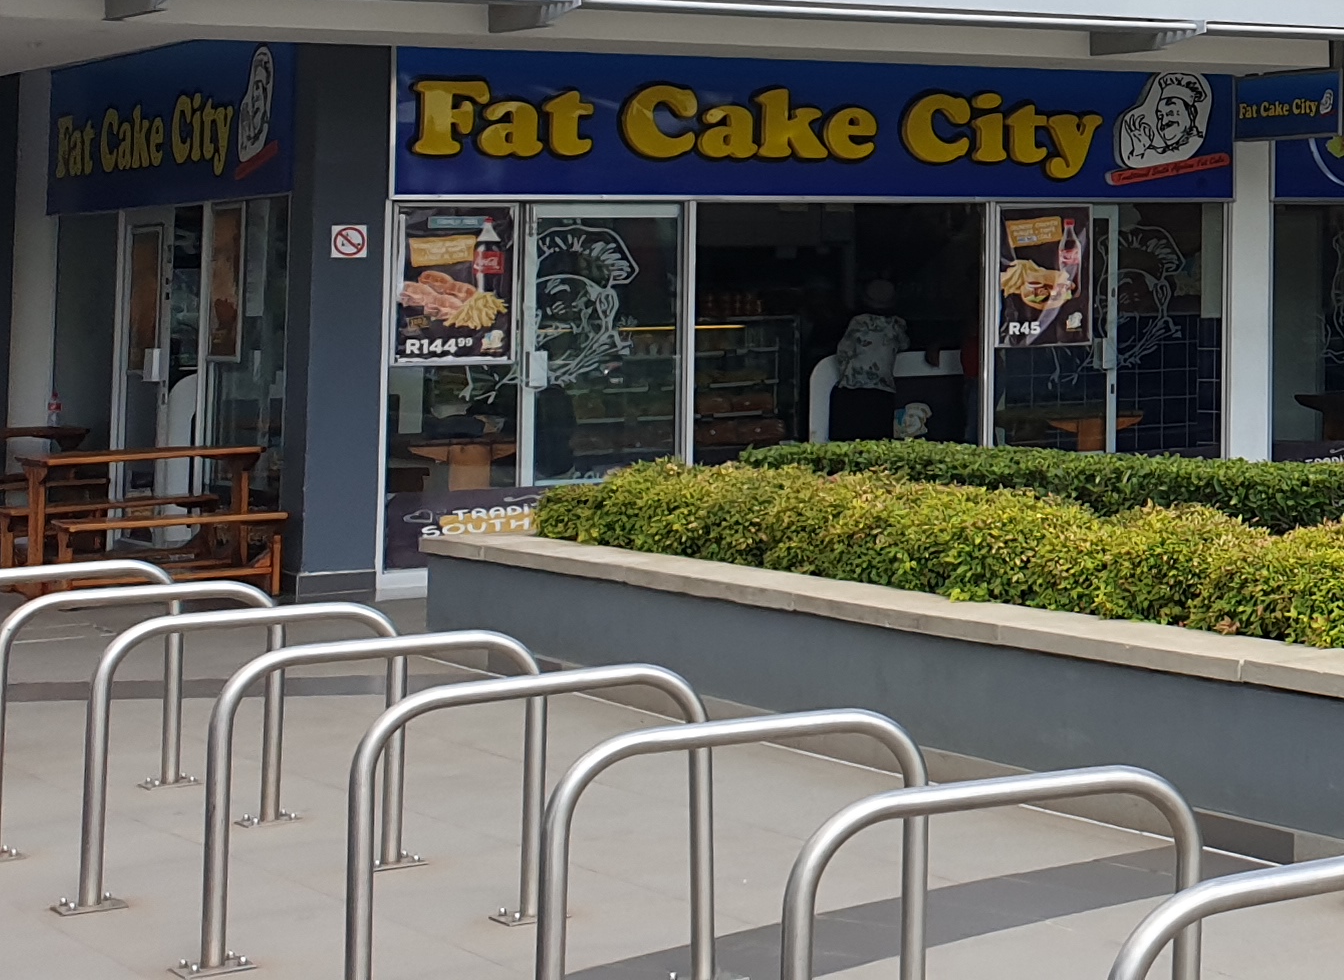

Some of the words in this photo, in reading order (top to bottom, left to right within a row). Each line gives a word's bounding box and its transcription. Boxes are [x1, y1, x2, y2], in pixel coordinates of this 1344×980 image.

[1239, 103, 1257, 119] Fat
[1260, 100, 1290, 117] Cake
[1292, 98, 1318, 117] City
[56, 115, 96, 178] Fat
[101, 104, 164, 173] Cake
[172, 92, 234, 177] City
[410, 79, 595, 158] Fat
[619, 83, 878, 161] Cake
[902, 90, 1103, 181] City
[1008, 321, 1041, 335] R45
[452, 502, 538, 522] TRADI
[421, 518, 531, 538] SOUTH
